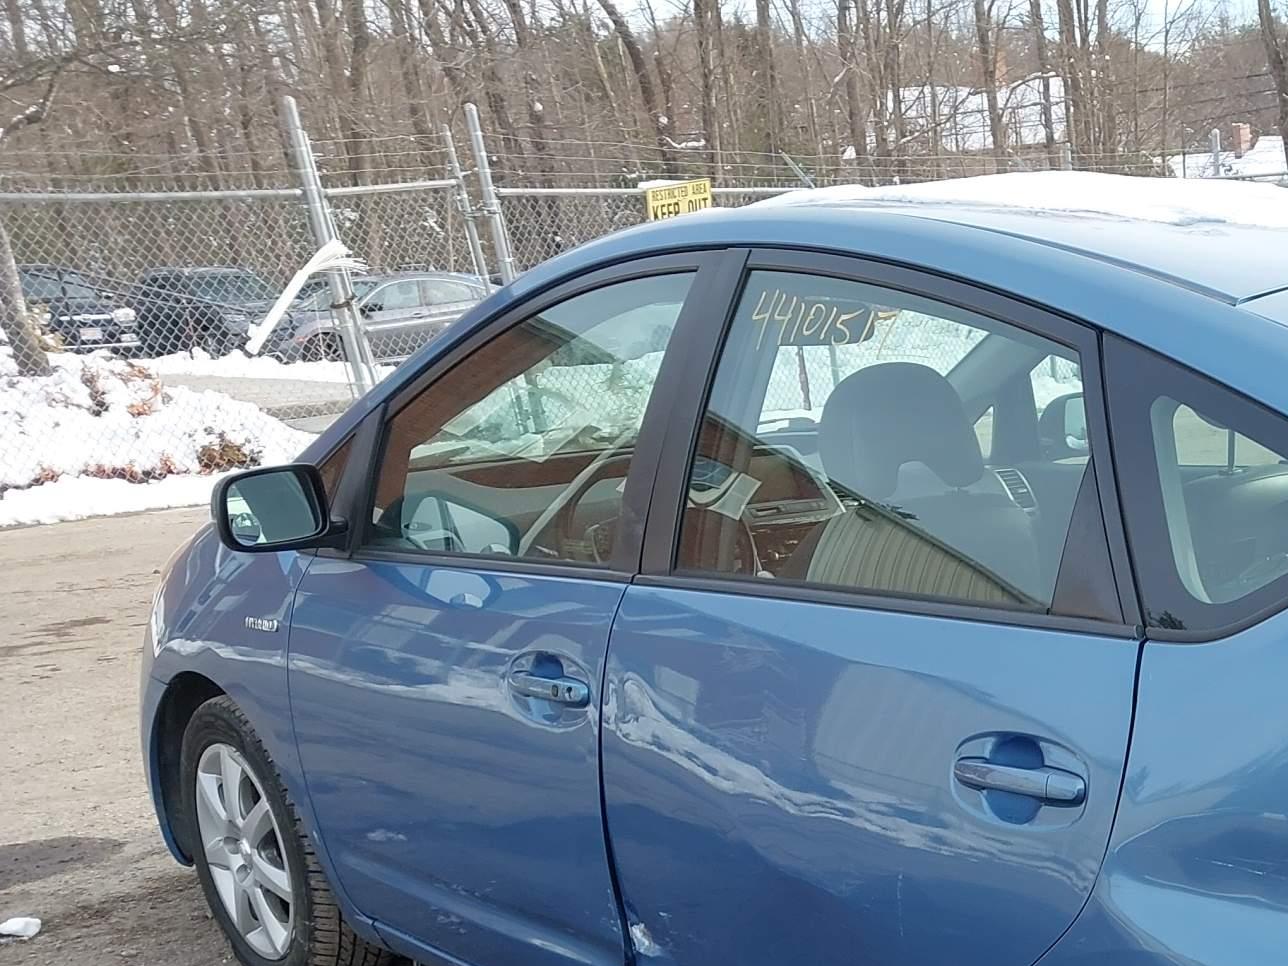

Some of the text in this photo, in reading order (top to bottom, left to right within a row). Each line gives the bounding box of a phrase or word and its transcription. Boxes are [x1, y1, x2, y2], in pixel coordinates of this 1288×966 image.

[652, 197, 709, 221] KEEP OUT
[752, 289, 899, 361] 44101517
